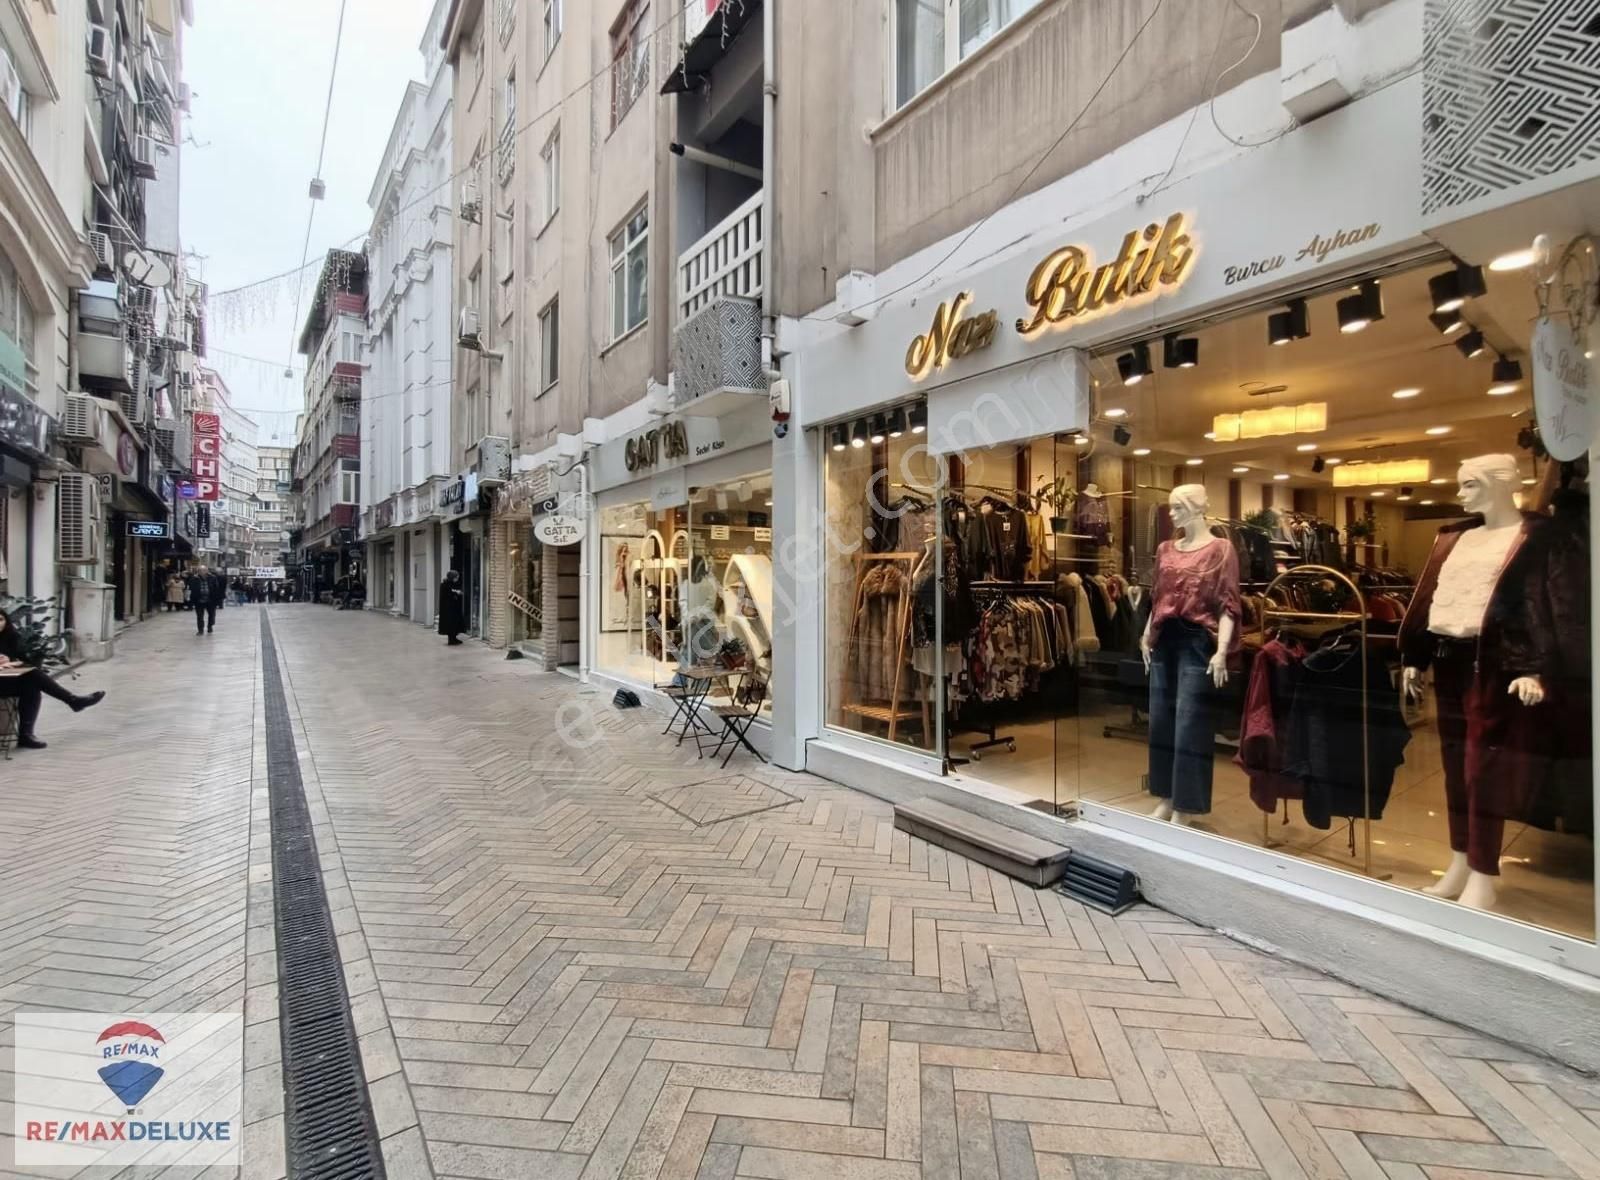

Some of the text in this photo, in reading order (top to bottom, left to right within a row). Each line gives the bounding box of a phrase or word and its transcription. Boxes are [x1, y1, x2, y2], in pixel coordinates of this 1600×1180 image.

[1224, 221, 1381, 285] Burcu Ayhan
[905, 212, 1194, 377] Naz Butik
[197, 438, 214, 498] CHP
[625, 419, 689, 473] GATTA
[544, 526, 578, 536] GATTA
